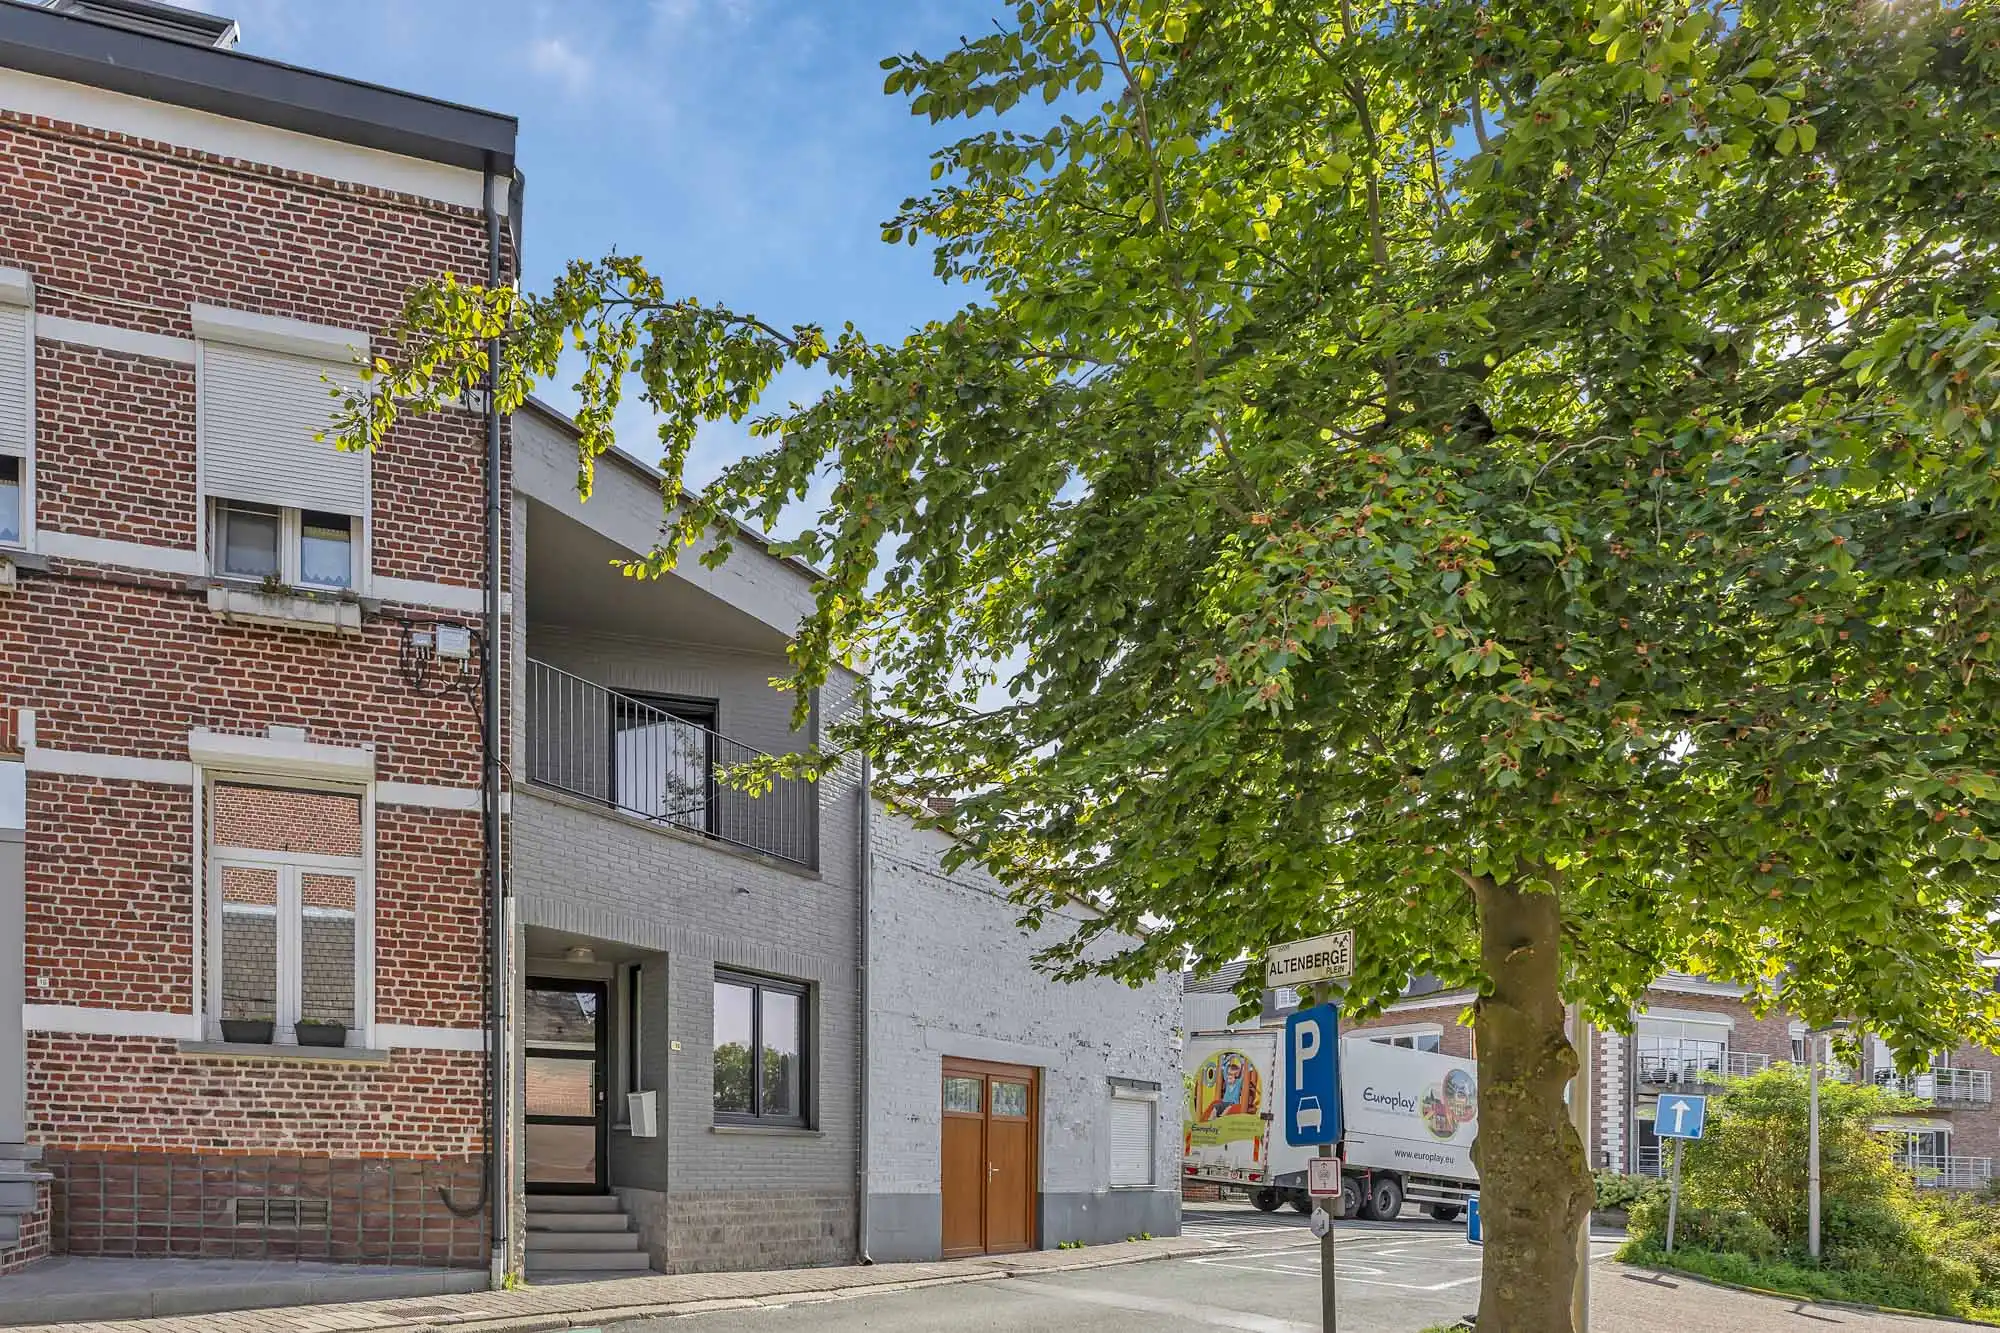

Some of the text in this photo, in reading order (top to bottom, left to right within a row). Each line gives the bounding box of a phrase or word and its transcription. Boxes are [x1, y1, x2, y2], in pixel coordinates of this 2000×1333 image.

[1269, 948, 1348, 976] ALTENBERGE
[1327, 965, 1345, 975] PLEIN
[1296, 1020, 1320, 1090] P
[1363, 1086, 1415, 1113] Europlay
[1394, 1149, 1454, 1164] www.europlay.eu
